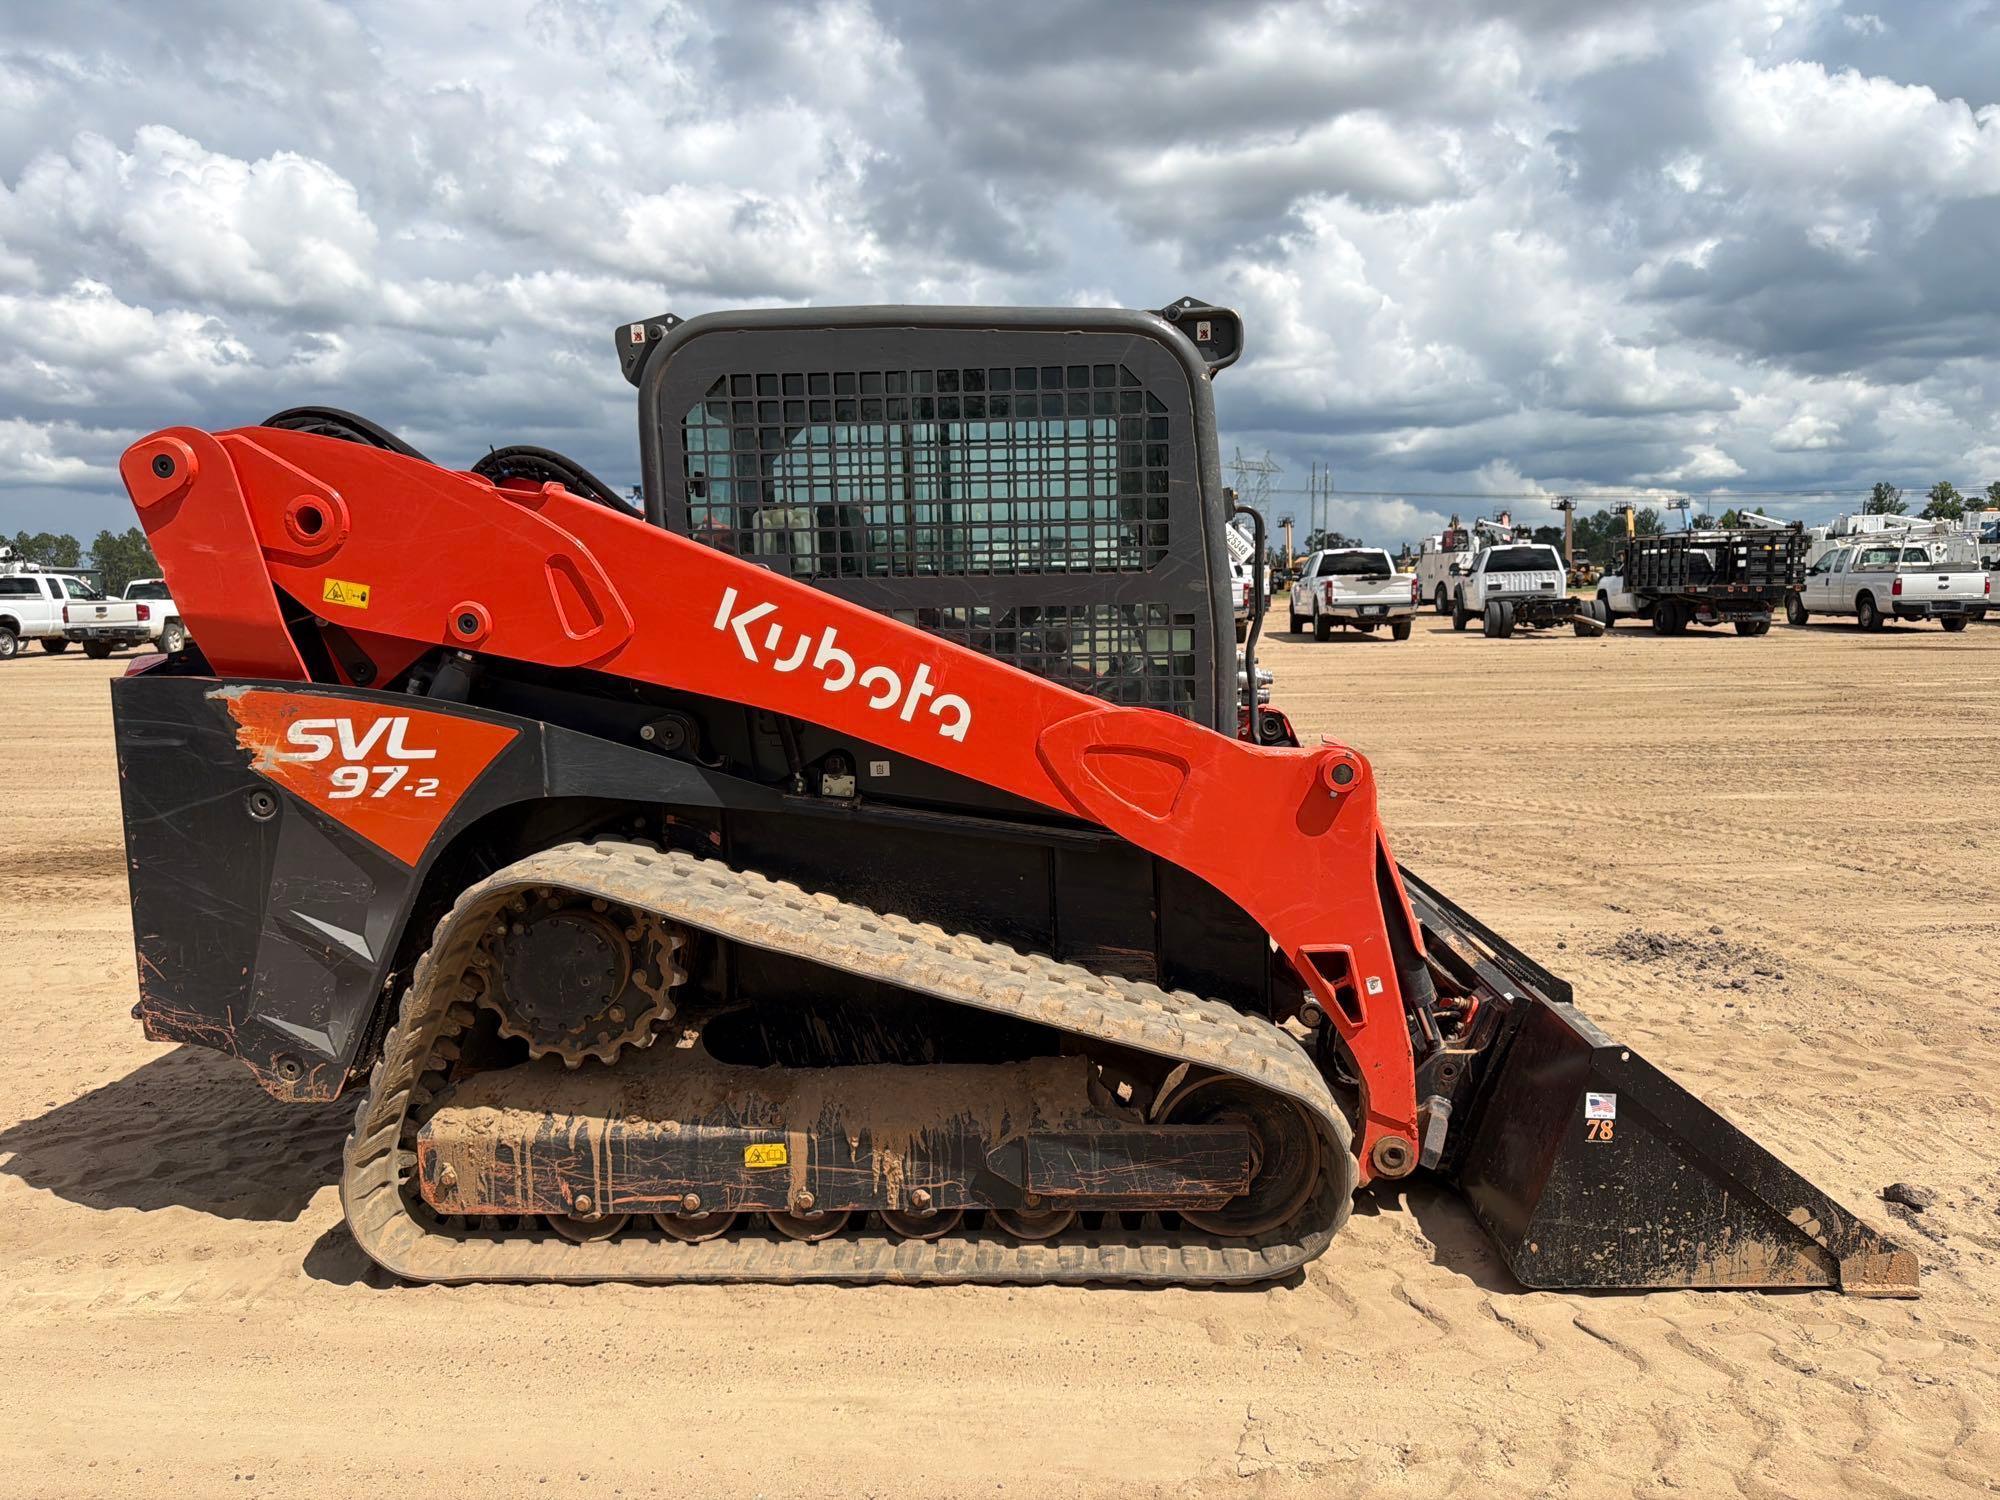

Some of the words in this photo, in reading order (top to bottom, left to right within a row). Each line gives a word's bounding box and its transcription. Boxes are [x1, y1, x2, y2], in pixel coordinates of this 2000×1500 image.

[713, 586, 972, 743] Kubota
[279, 716, 436, 762] SVL
[328, 765, 440, 799] 97-2
[1586, 1119, 1614, 1140] 78
